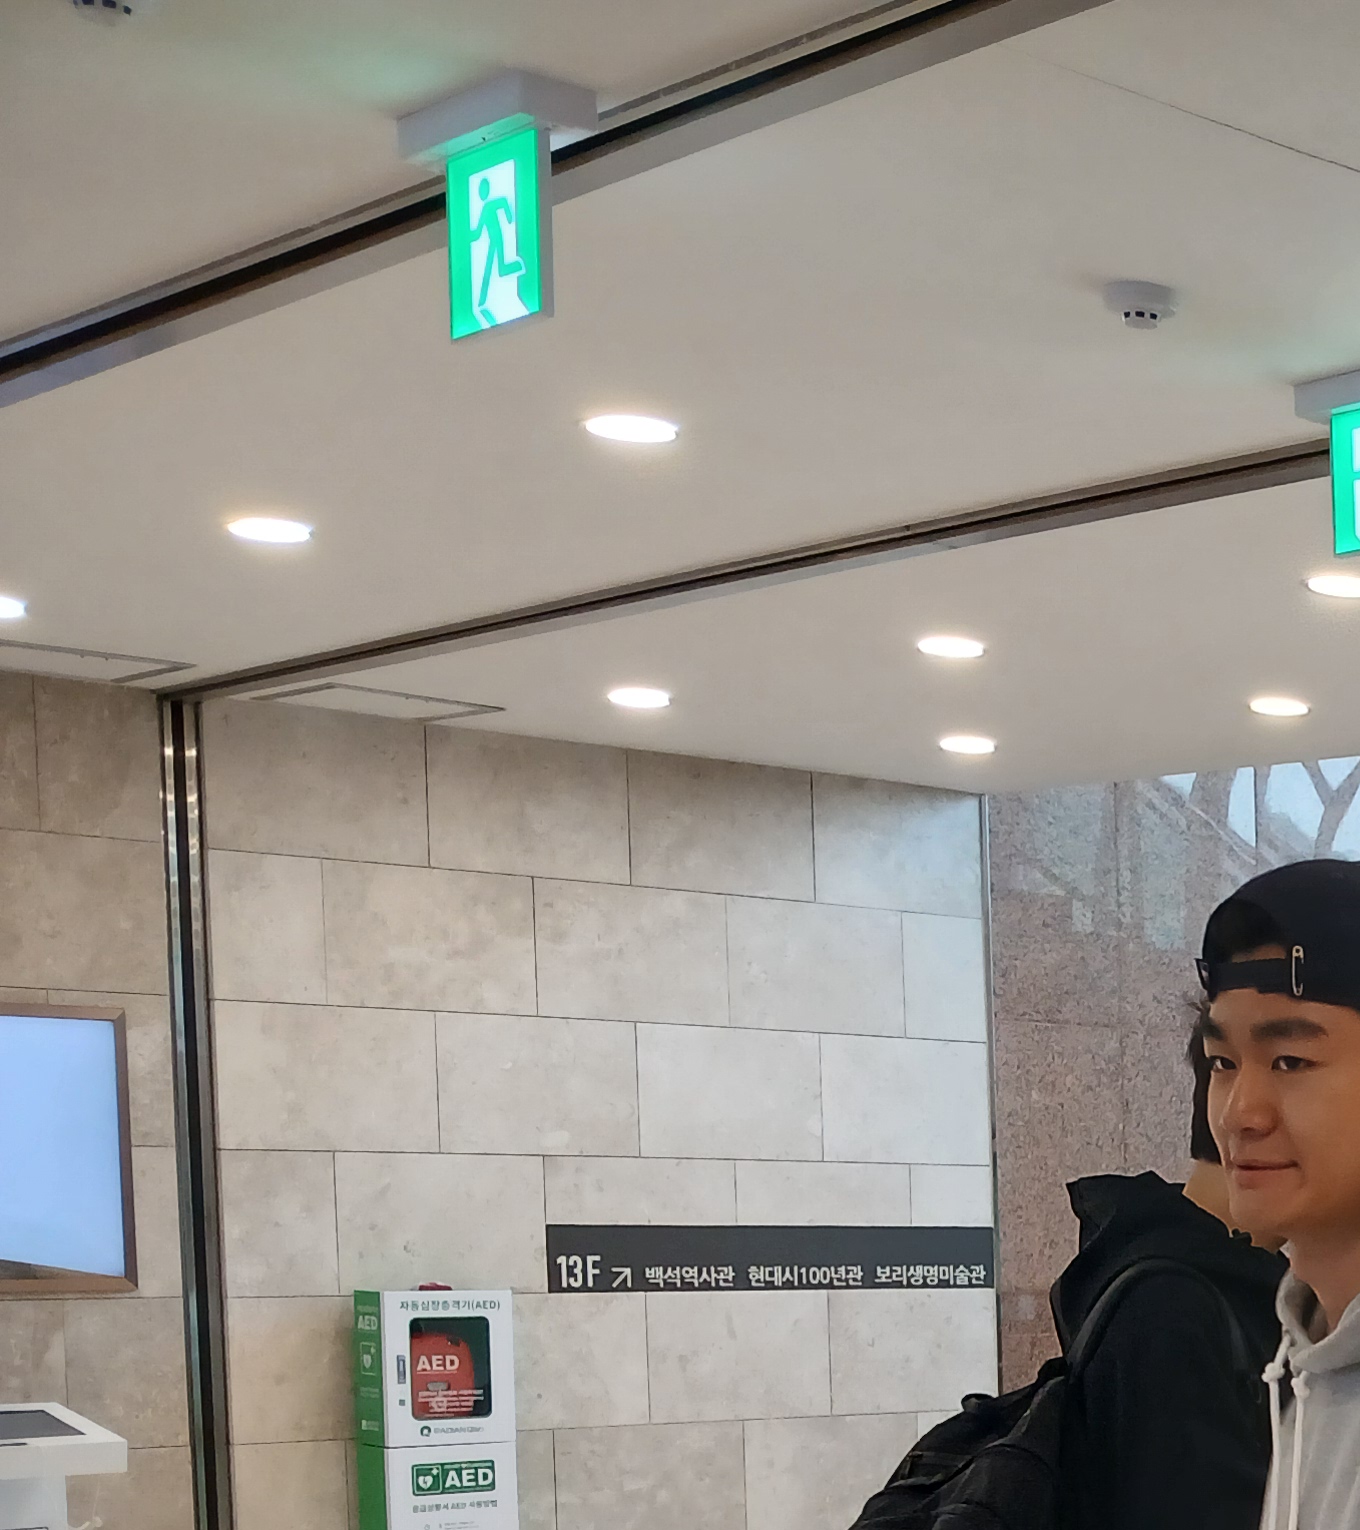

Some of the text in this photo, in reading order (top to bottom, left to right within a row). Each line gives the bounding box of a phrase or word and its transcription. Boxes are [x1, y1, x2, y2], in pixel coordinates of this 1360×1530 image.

[556, 1255, 987, 1288] 13F 백석역사관 현대시100년관 보리생명미술관
[357, 1316, 378, 1330] AED
[416, 1354, 460, 1371] AED
[444, 1468, 494, 1488] AED
